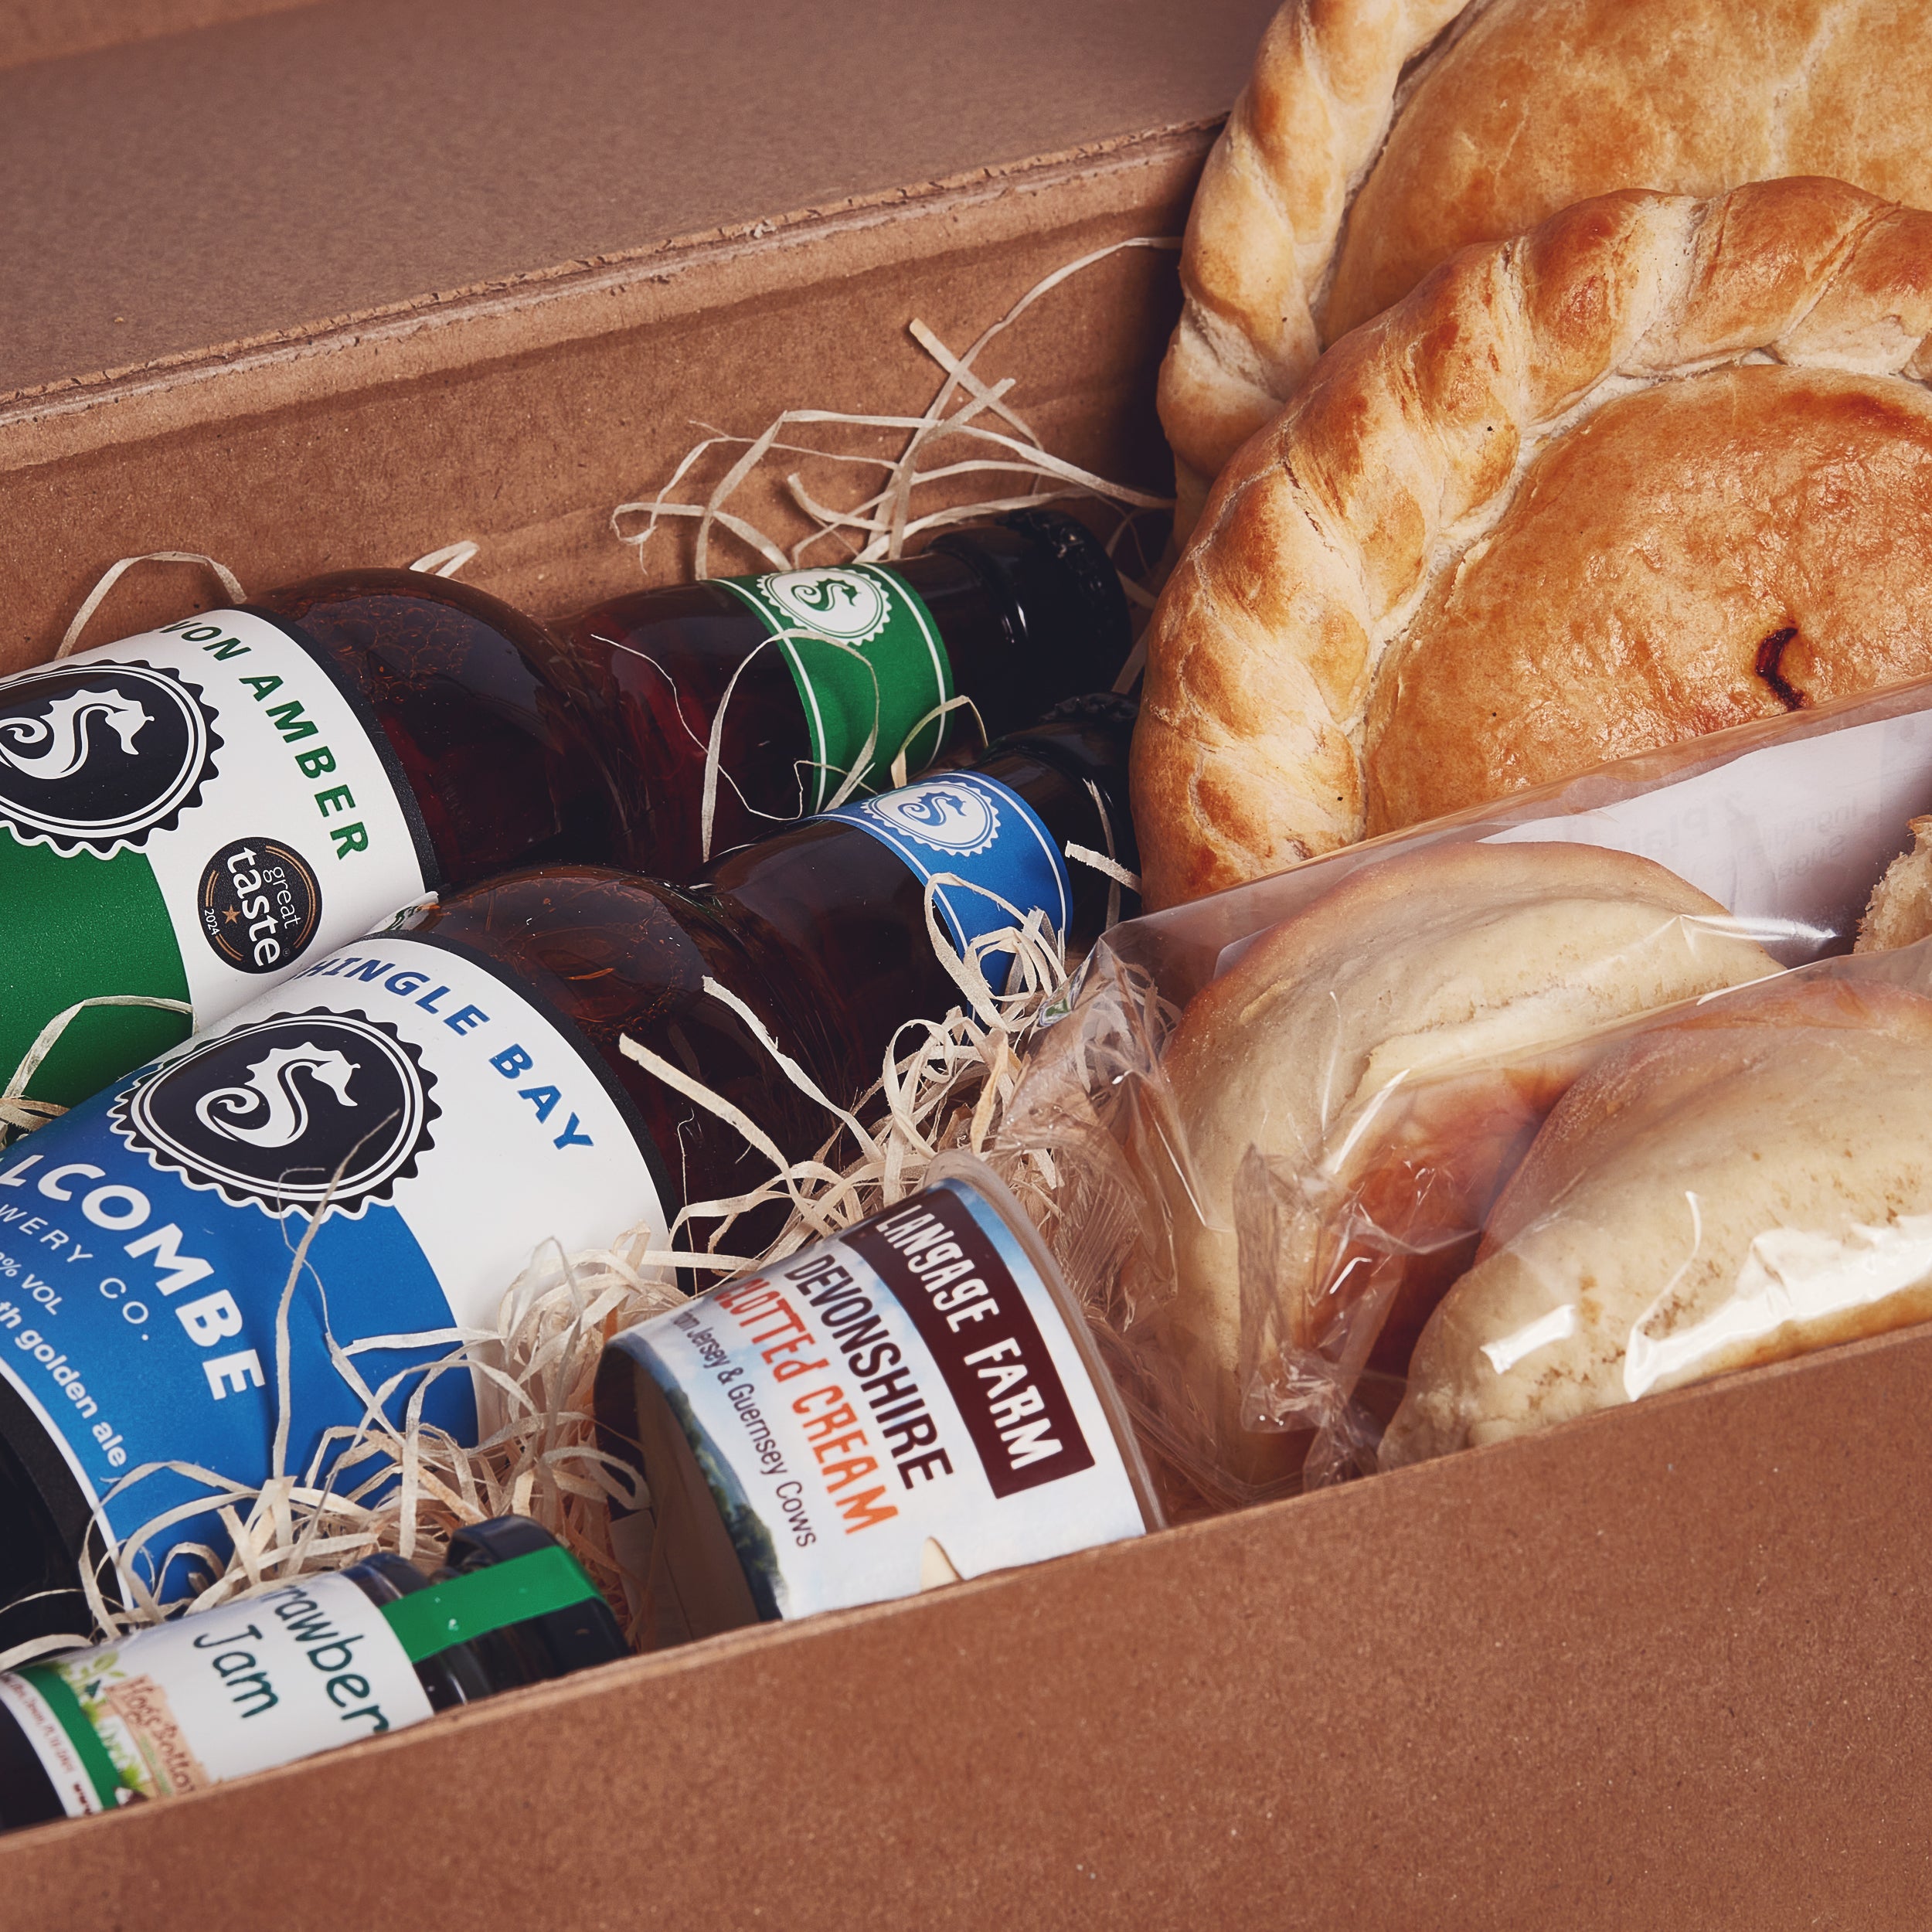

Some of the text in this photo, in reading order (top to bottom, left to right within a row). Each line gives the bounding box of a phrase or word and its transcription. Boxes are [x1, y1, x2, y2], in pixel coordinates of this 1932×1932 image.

[238, 675, 369, 861] AMBER
[204, 908, 220, 936] 2024
[226, 846, 281, 967] taste
[262, 866, 302, 930] great
[488, 1043, 594, 1150] BAY
[0, 1154, 266, 1401] LCOMBE
[21, 1273, 63, 1315] VOL
[99, 1277, 149, 1341] CO.
[686, 1326, 731, 1369] Jersey
[716, 1366, 744, 1386] &
[783, 1253, 954, 1491] DEVONSHIRE
[14, 1329, 99, 1420] golden
[91, 1421, 128, 1468] ale
[727, 1383, 788, 1477] Guernsey
[963, 1337, 1063, 1471] FARM
[791, 1384, 900, 1536] CREAM
[775, 1480, 817, 1548] Cows
[192, 1624, 280, 1719] Jam
[260, 1584, 389, 1733] rawber
